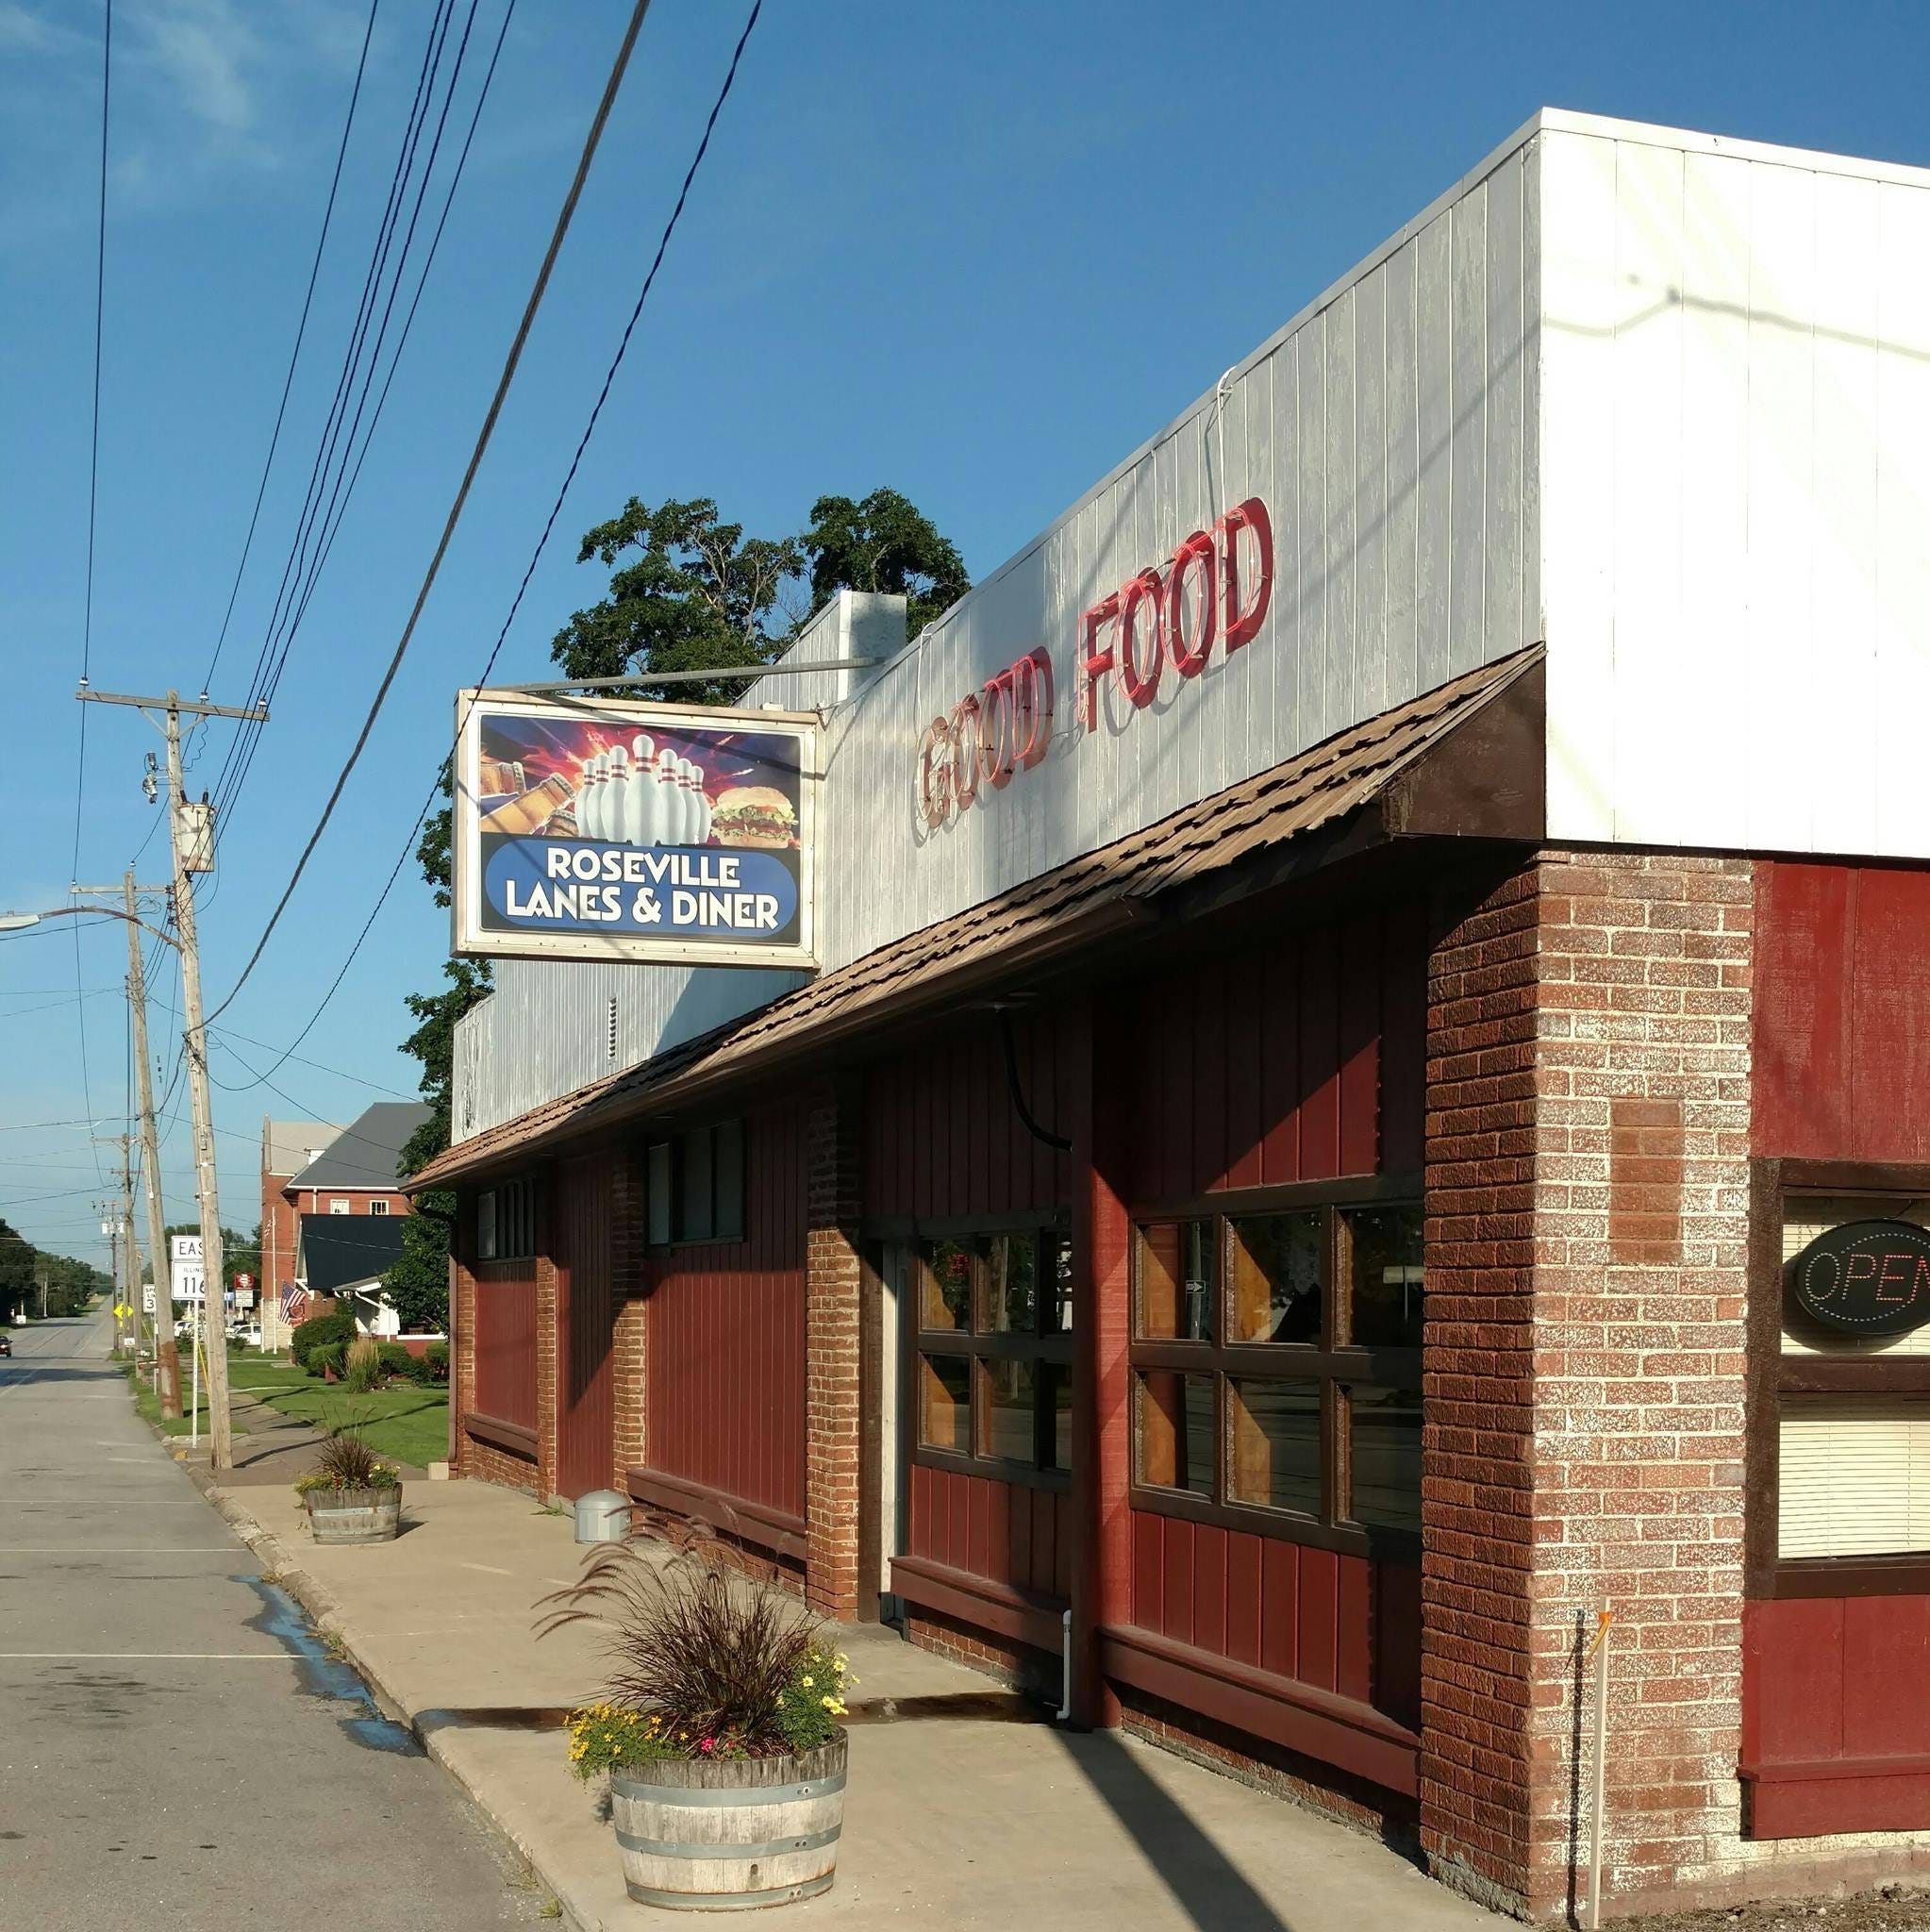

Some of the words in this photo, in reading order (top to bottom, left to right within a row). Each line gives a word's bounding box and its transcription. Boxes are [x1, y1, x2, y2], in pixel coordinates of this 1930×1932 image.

[918, 646, 1054, 828] GOOD
[1077, 497, 1274, 733] FOOD
[546, 847, 740, 889] ROSEVILLE
[505, 879, 622, 923] LANES
[631, 887, 662, 924] &
[672, 890, 780, 931] DINER
[146, 1298, 155, 1309] 3
